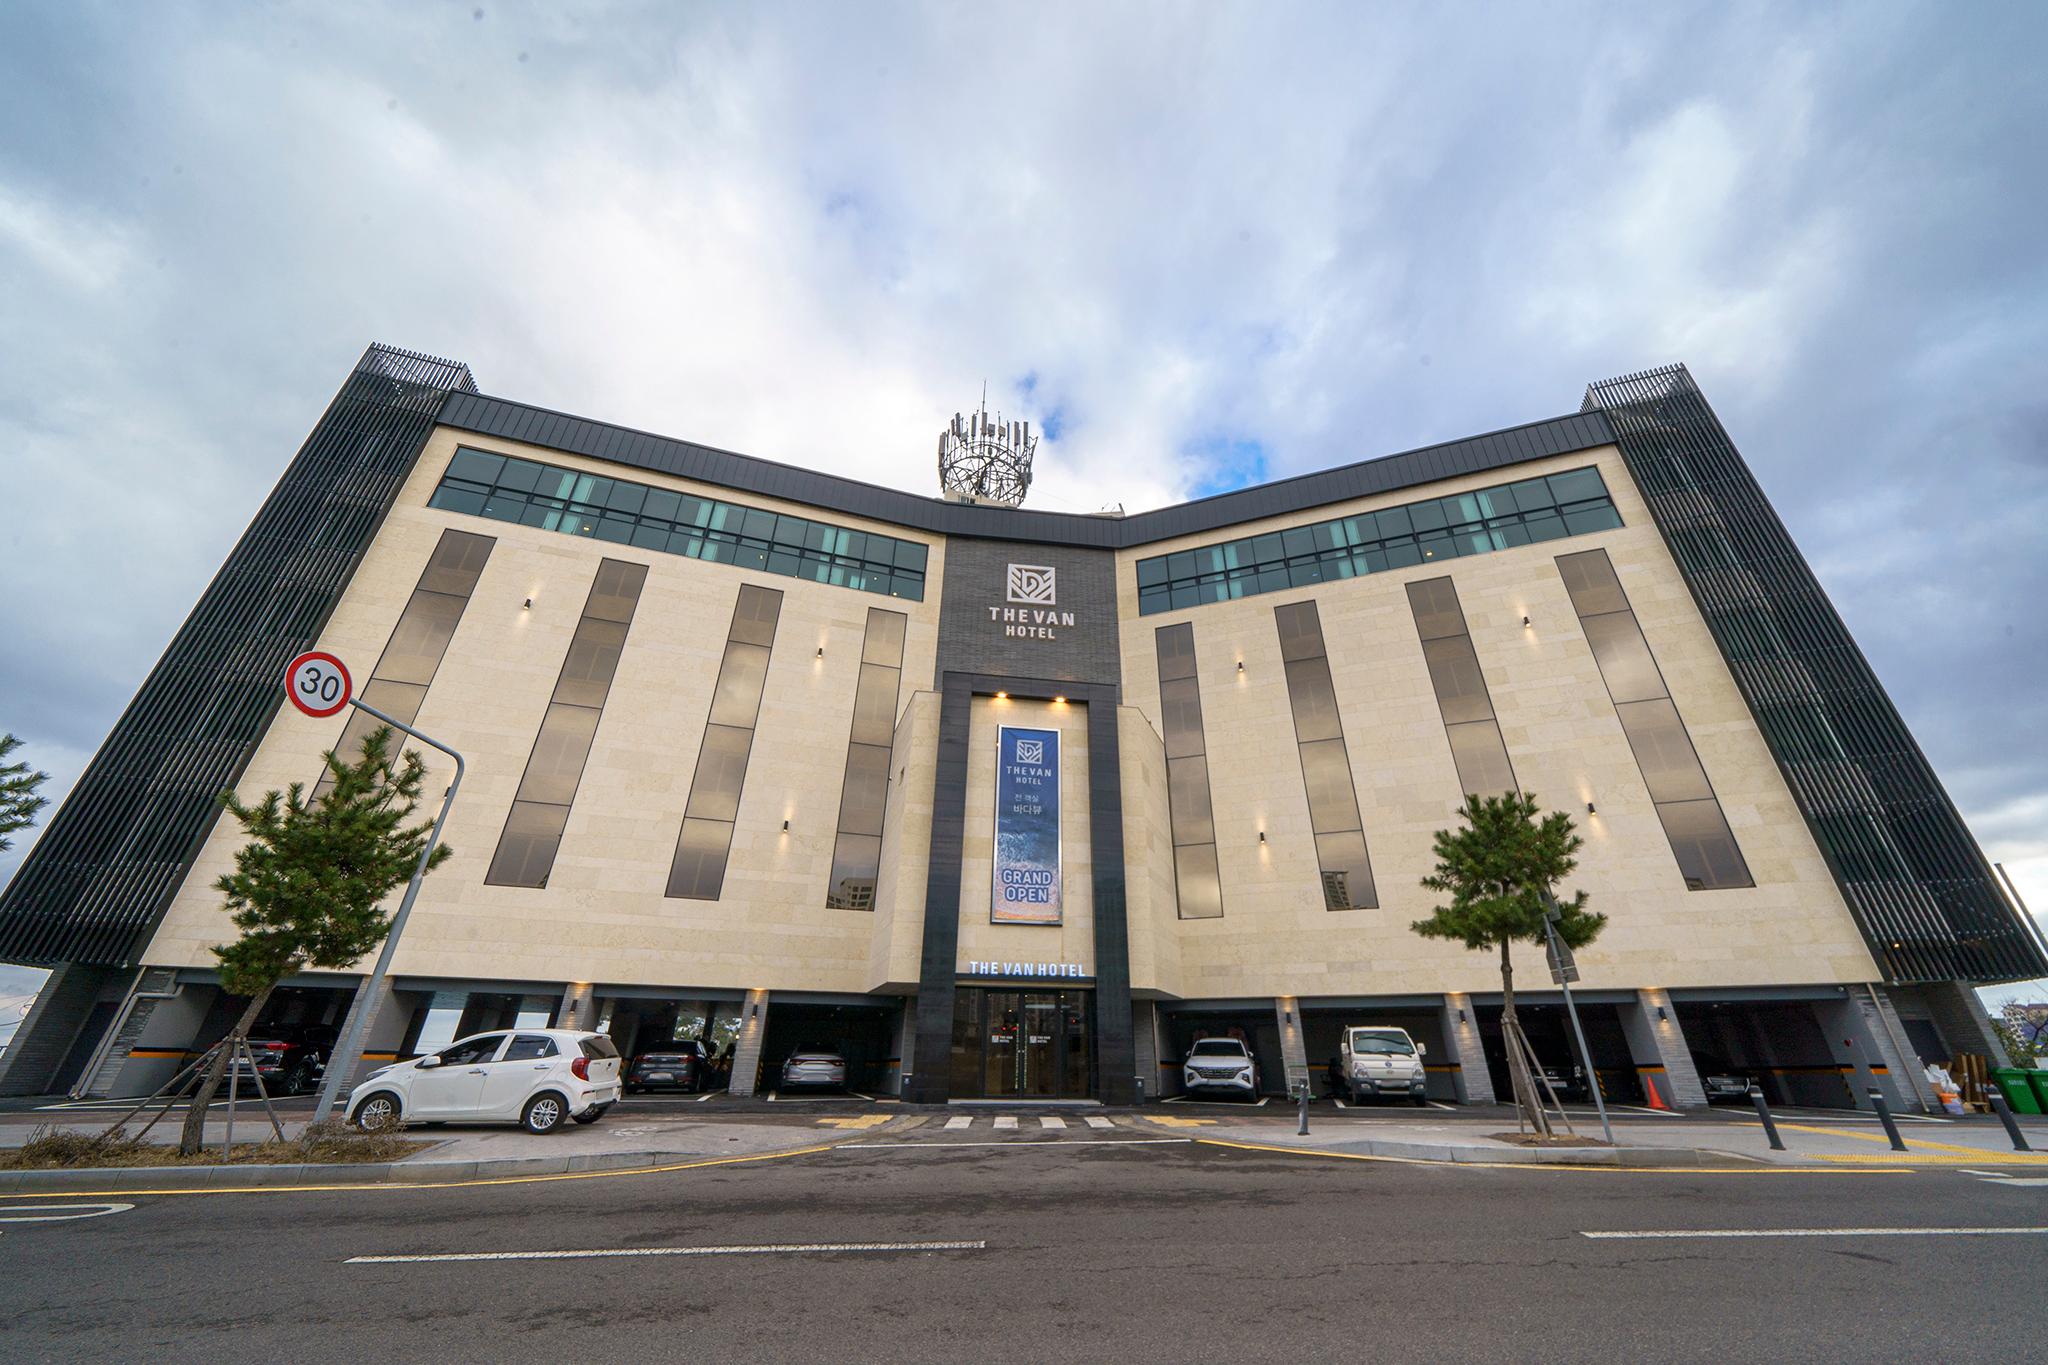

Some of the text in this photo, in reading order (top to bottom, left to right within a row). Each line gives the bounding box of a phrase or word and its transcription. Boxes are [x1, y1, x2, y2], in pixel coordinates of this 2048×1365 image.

[1005, 625, 1056, 640] HOTEL
[300, 667, 340, 702] 30
[1015, 777, 1042, 786] HOTEL
[1002, 869, 1052, 885] GRAND
[1006, 887, 1048, 902] OPEN
[970, 961, 1086, 977] THE VAN HOTEL
